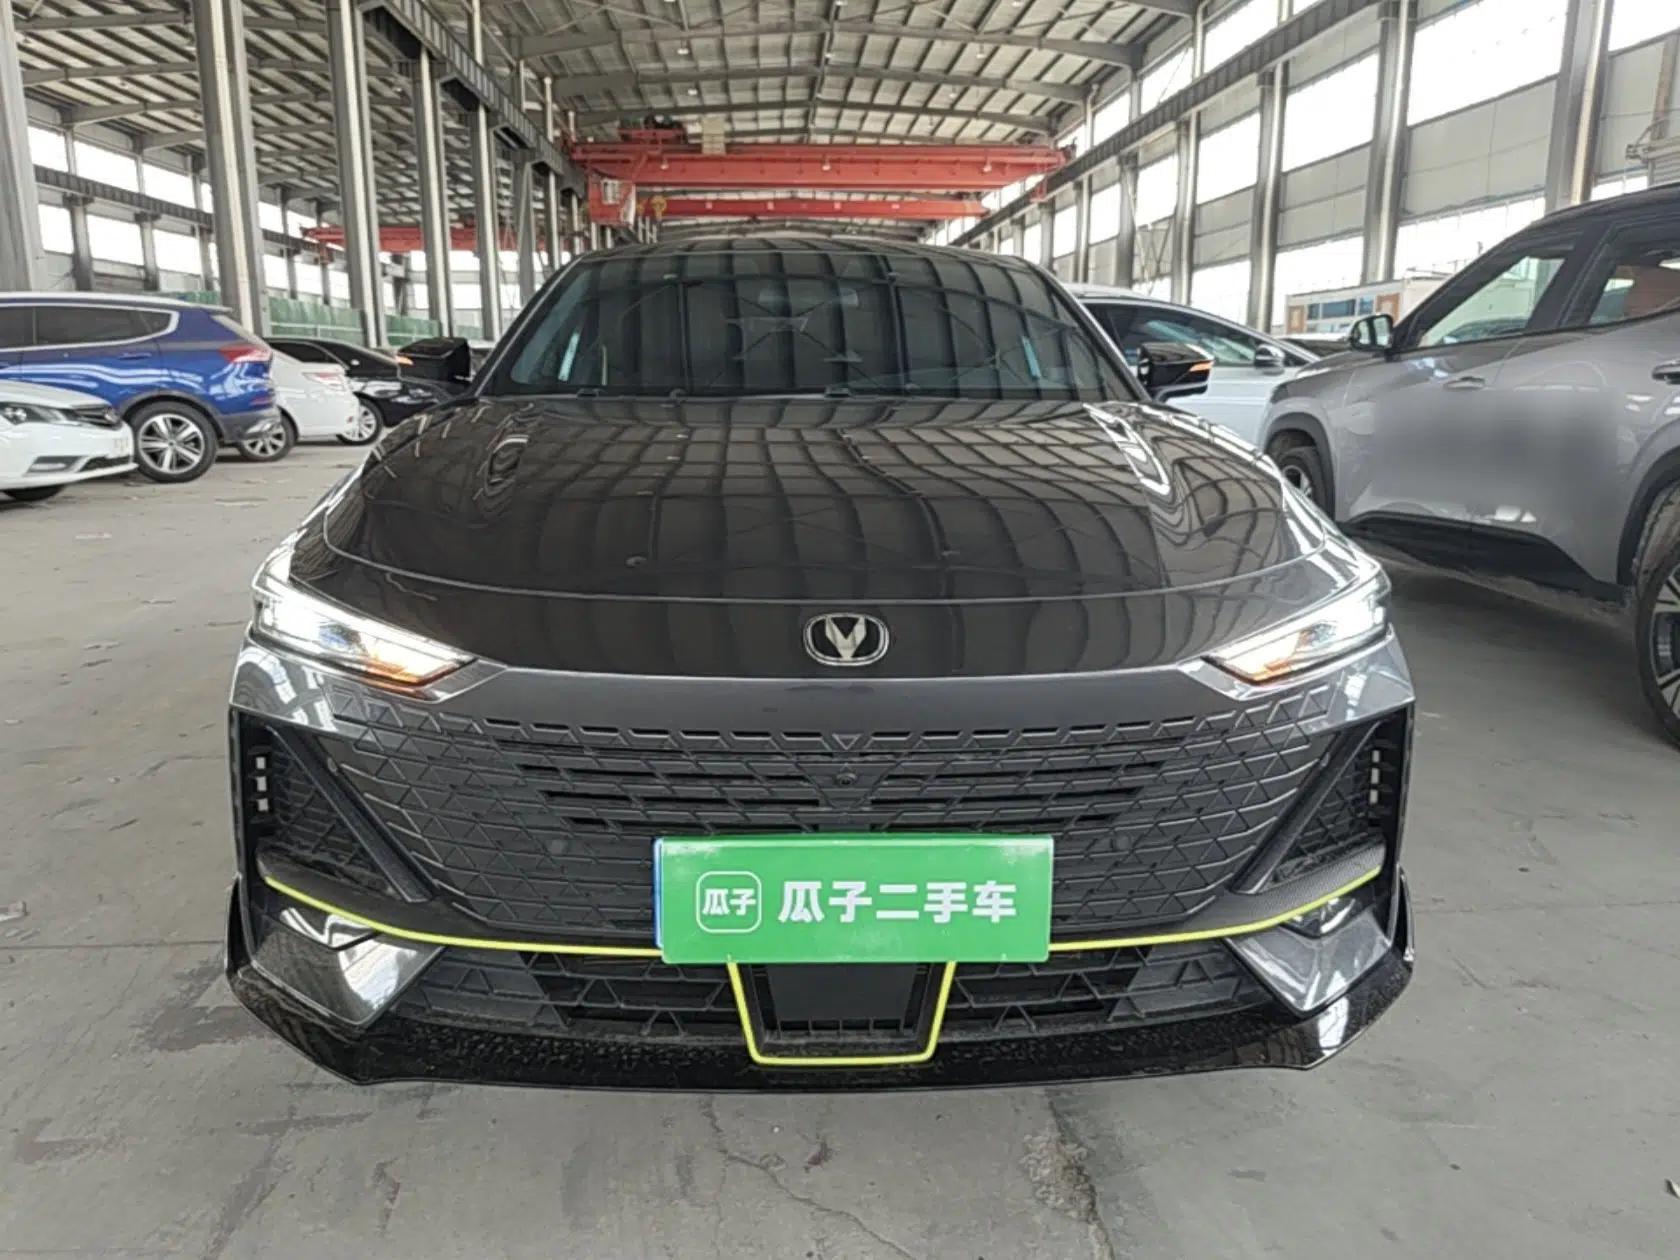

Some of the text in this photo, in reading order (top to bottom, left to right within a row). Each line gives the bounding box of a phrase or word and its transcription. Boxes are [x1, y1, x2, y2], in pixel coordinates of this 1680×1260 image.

[702, 888, 757, 916] 瓜子
[778, 880, 1016, 923] 瓜子二手车
